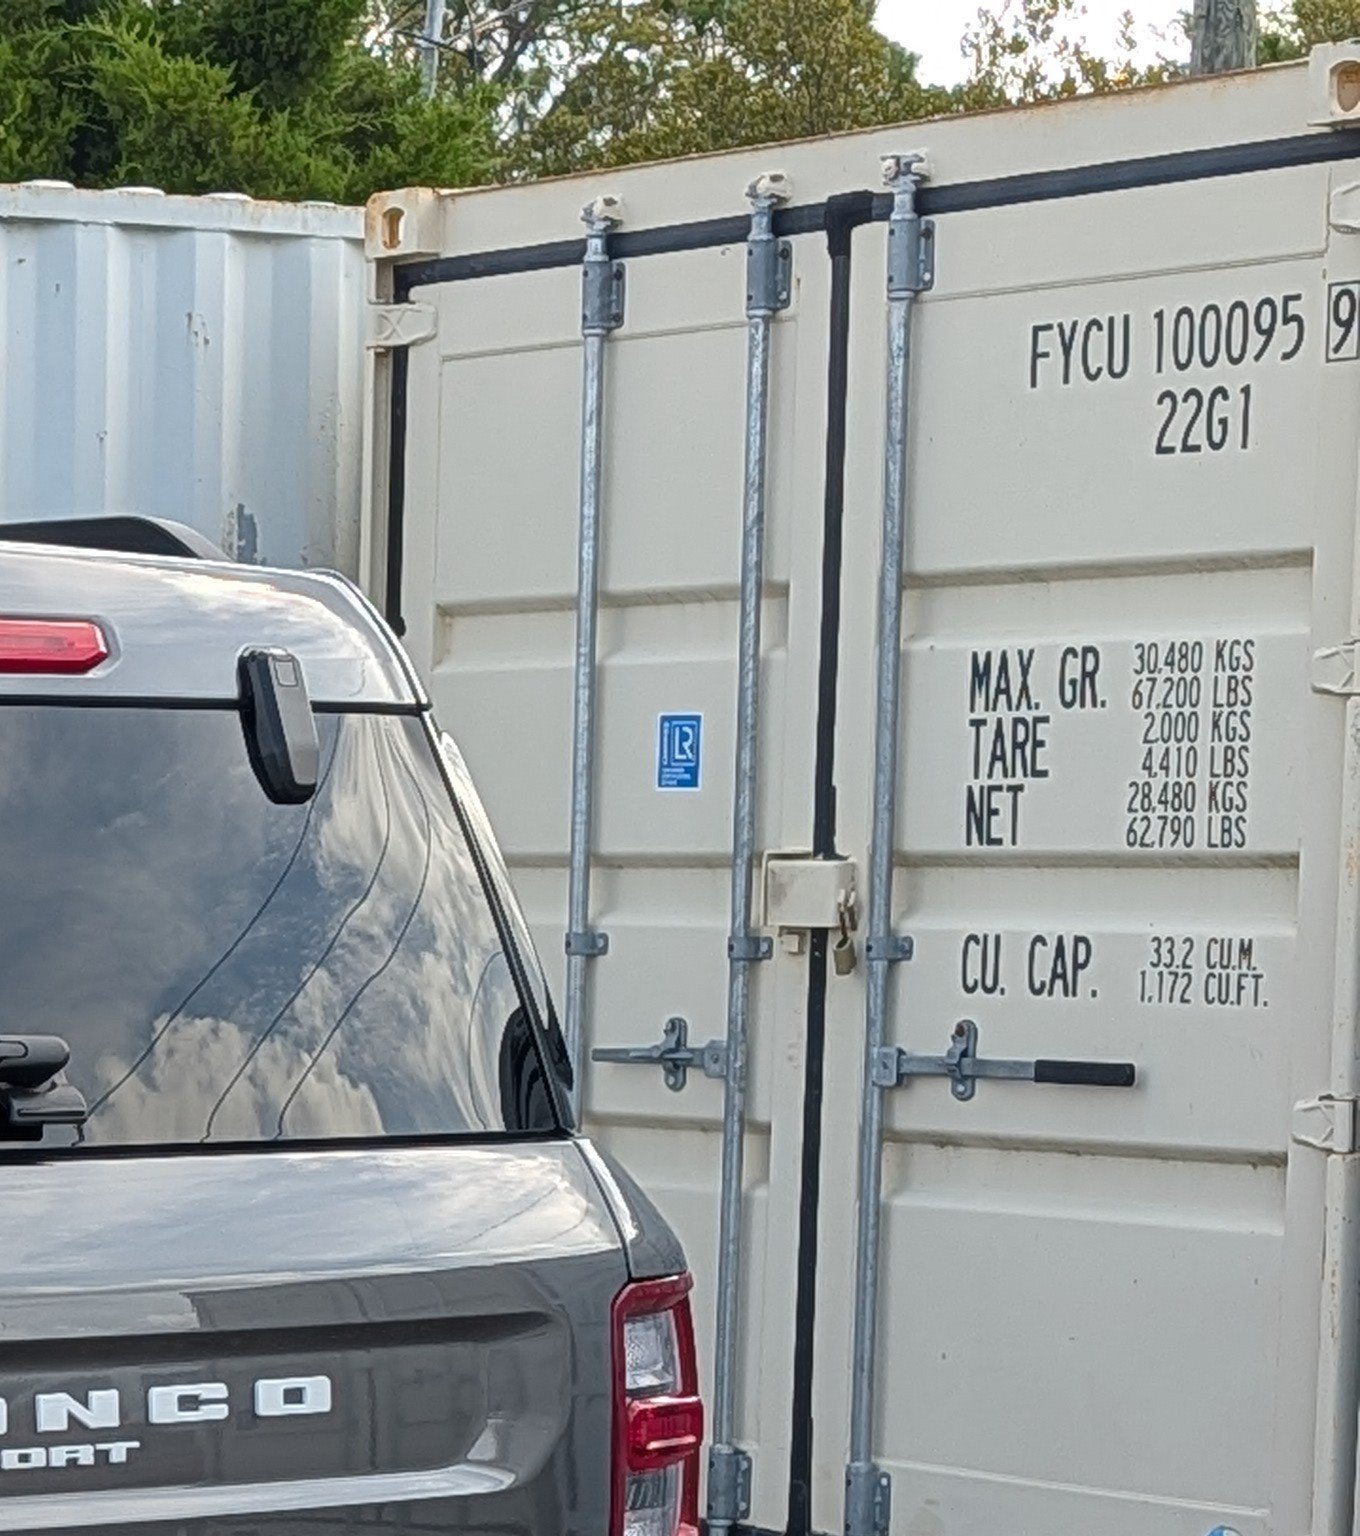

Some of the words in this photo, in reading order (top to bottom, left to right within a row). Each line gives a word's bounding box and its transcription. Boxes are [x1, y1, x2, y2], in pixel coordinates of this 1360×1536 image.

[1030, 314, 1130, 389] FYCU
[1153, 293, 1305, 374] 100095
[1155, 383, 1251, 455] 22G1
[1214, 639, 1255, 673] KGS
[969, 648, 1040, 714] MAX.
[1058, 645, 1107, 710] GR.
[1212, 674, 1253, 709] LBS
[1211, 709, 1251, 743] KGS
[969, 715, 1050, 780] TARE
[1209, 744, 1250, 779] LBS
[1208, 780, 1248, 814] KGS
[965, 783, 1025, 847] NET
[1206, 815, 1247, 849] LBS
[961, 933, 1005, 996] CU.
[1028, 934, 1098, 998] CAP.
[1149, 936, 1194, 970] 33.2
